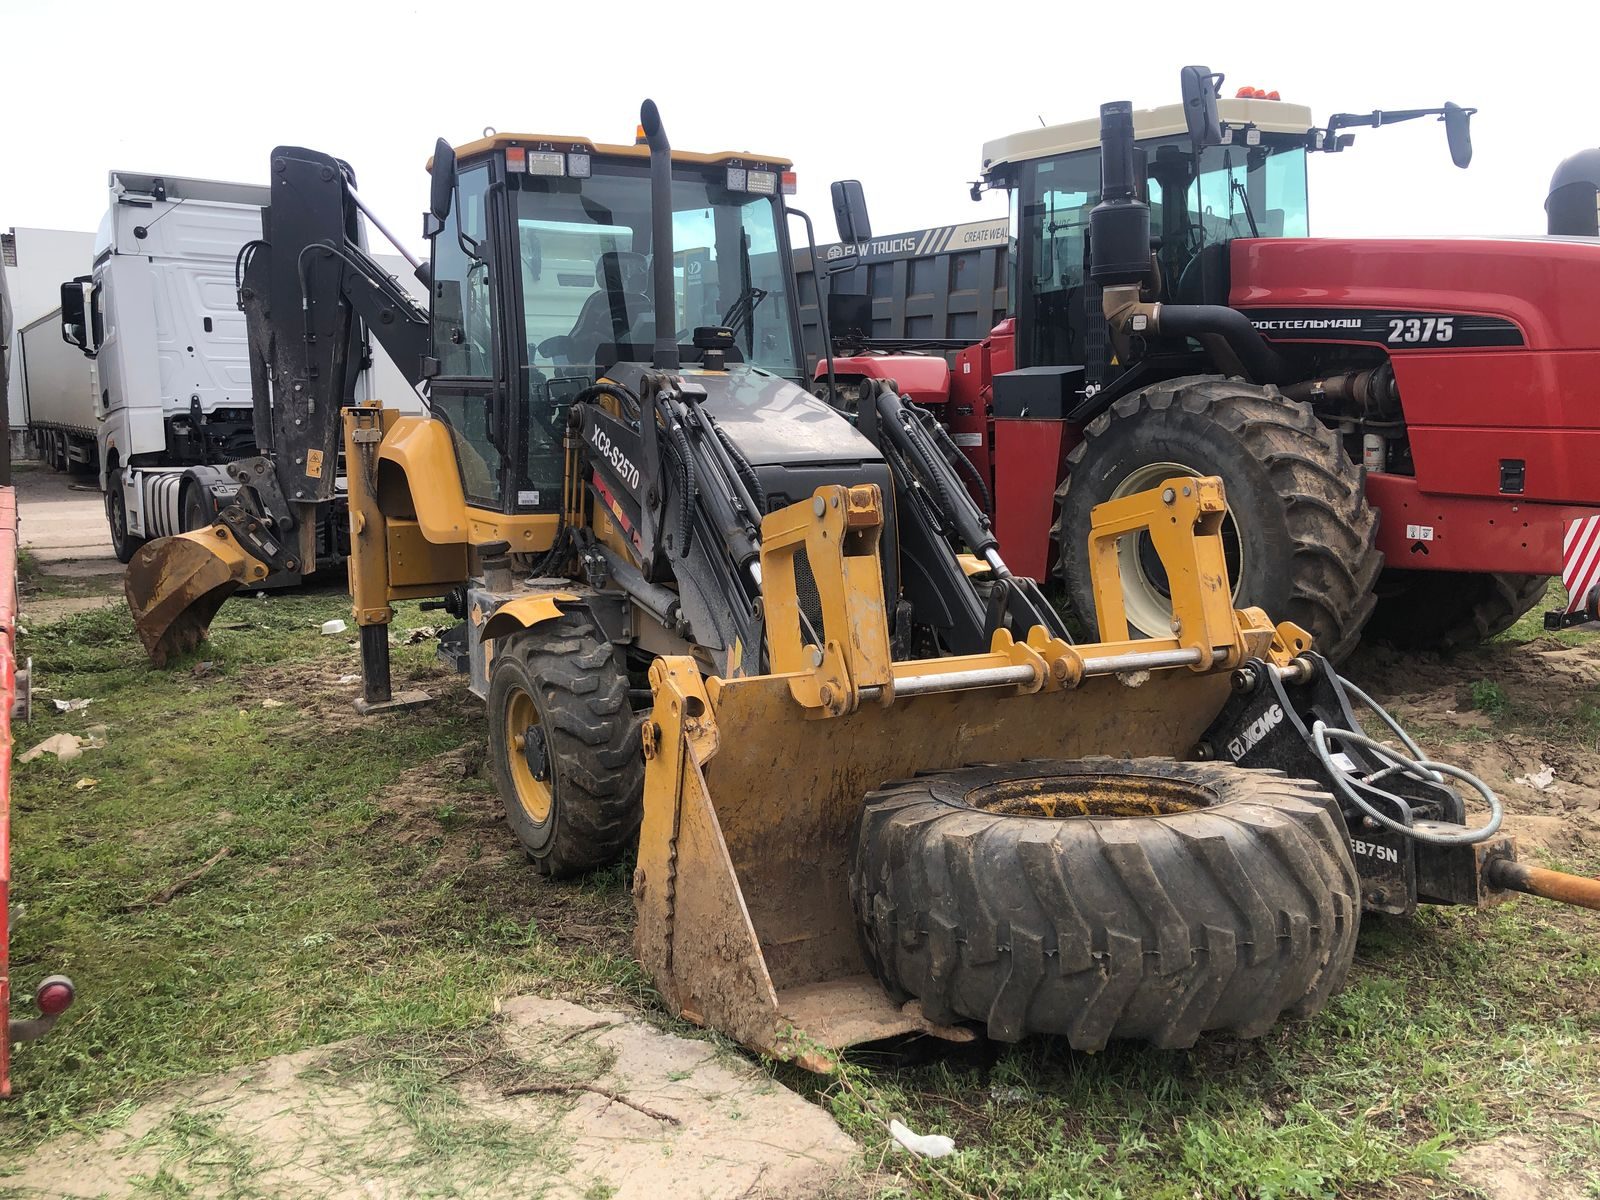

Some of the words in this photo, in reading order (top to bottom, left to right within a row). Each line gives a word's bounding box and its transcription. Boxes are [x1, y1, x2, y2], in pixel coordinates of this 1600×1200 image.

[872, 237, 916, 255] TRUCKS
[963, 230, 989, 243] CREATE
[1387, 317, 1453, 342] 2375
[591, 423, 640, 490] XC8-S2570
[1240, 703, 1284, 752] XCMG
